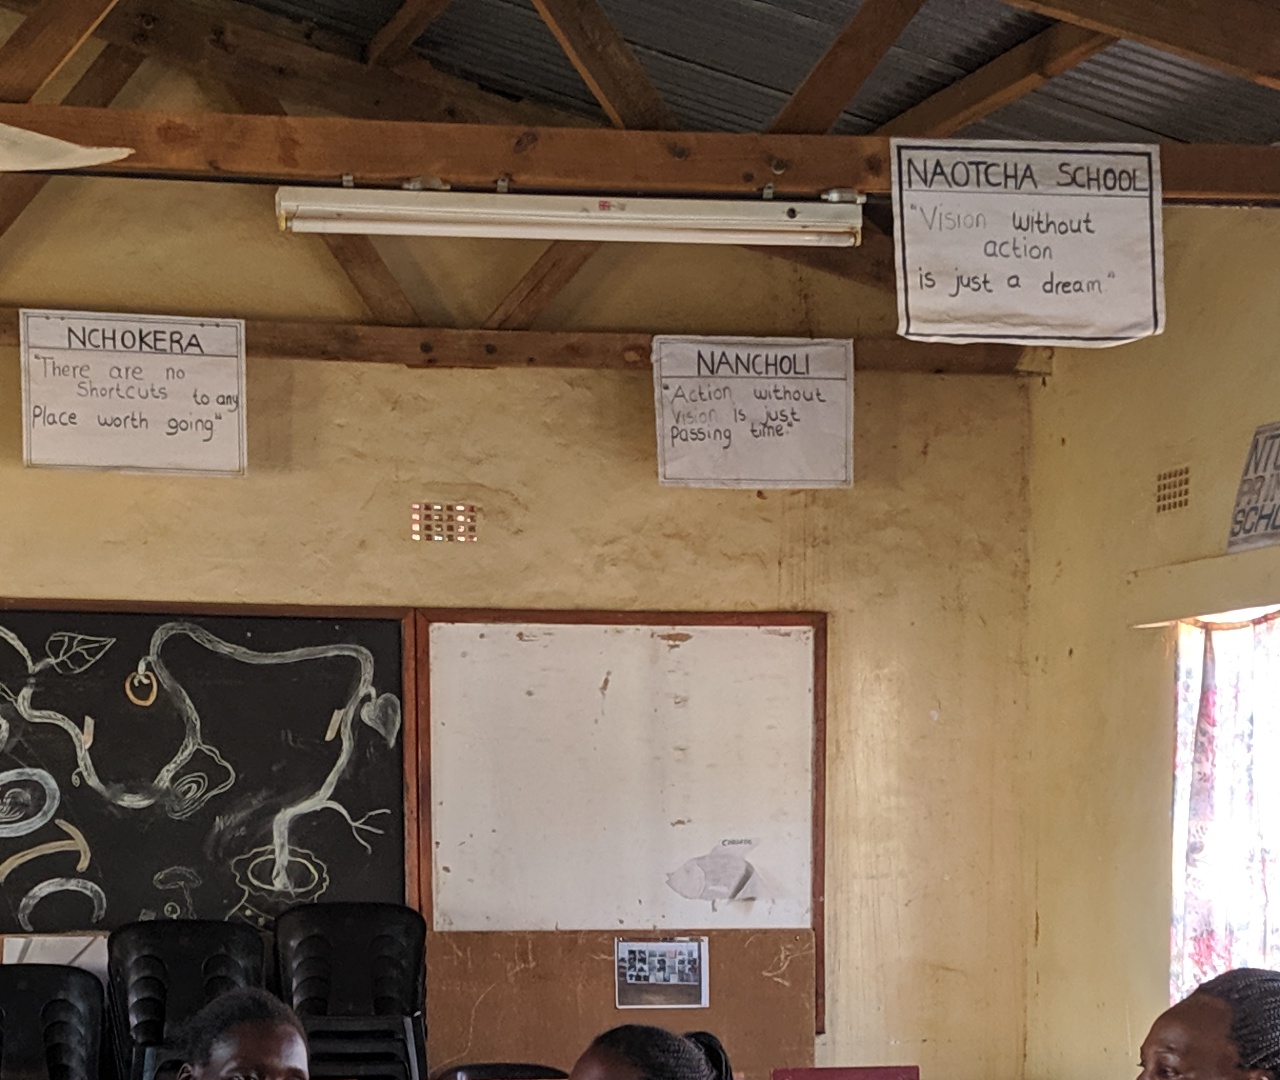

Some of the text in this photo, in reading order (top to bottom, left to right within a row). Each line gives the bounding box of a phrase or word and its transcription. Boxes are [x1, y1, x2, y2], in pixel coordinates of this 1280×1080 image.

[907, 158, 1149, 192] NAOTCHA SCHOOL
[983, 237, 1053, 260] action
[919, 267, 936, 291] is
[948, 267, 993, 297] just
[1007, 273, 1021, 288] a
[68, 326, 204, 354] NCHOKERA
[109, 365, 143, 380] are
[165, 366, 186, 380] no
[697, 349, 810, 377] NANCHOLI
[193, 389, 210, 406] to
[216, 393, 239, 413] any
[753, 384, 827, 402] without
[32, 405, 78, 429] Place
[97, 412, 149, 430] worth
[764, 406, 801, 428] just
